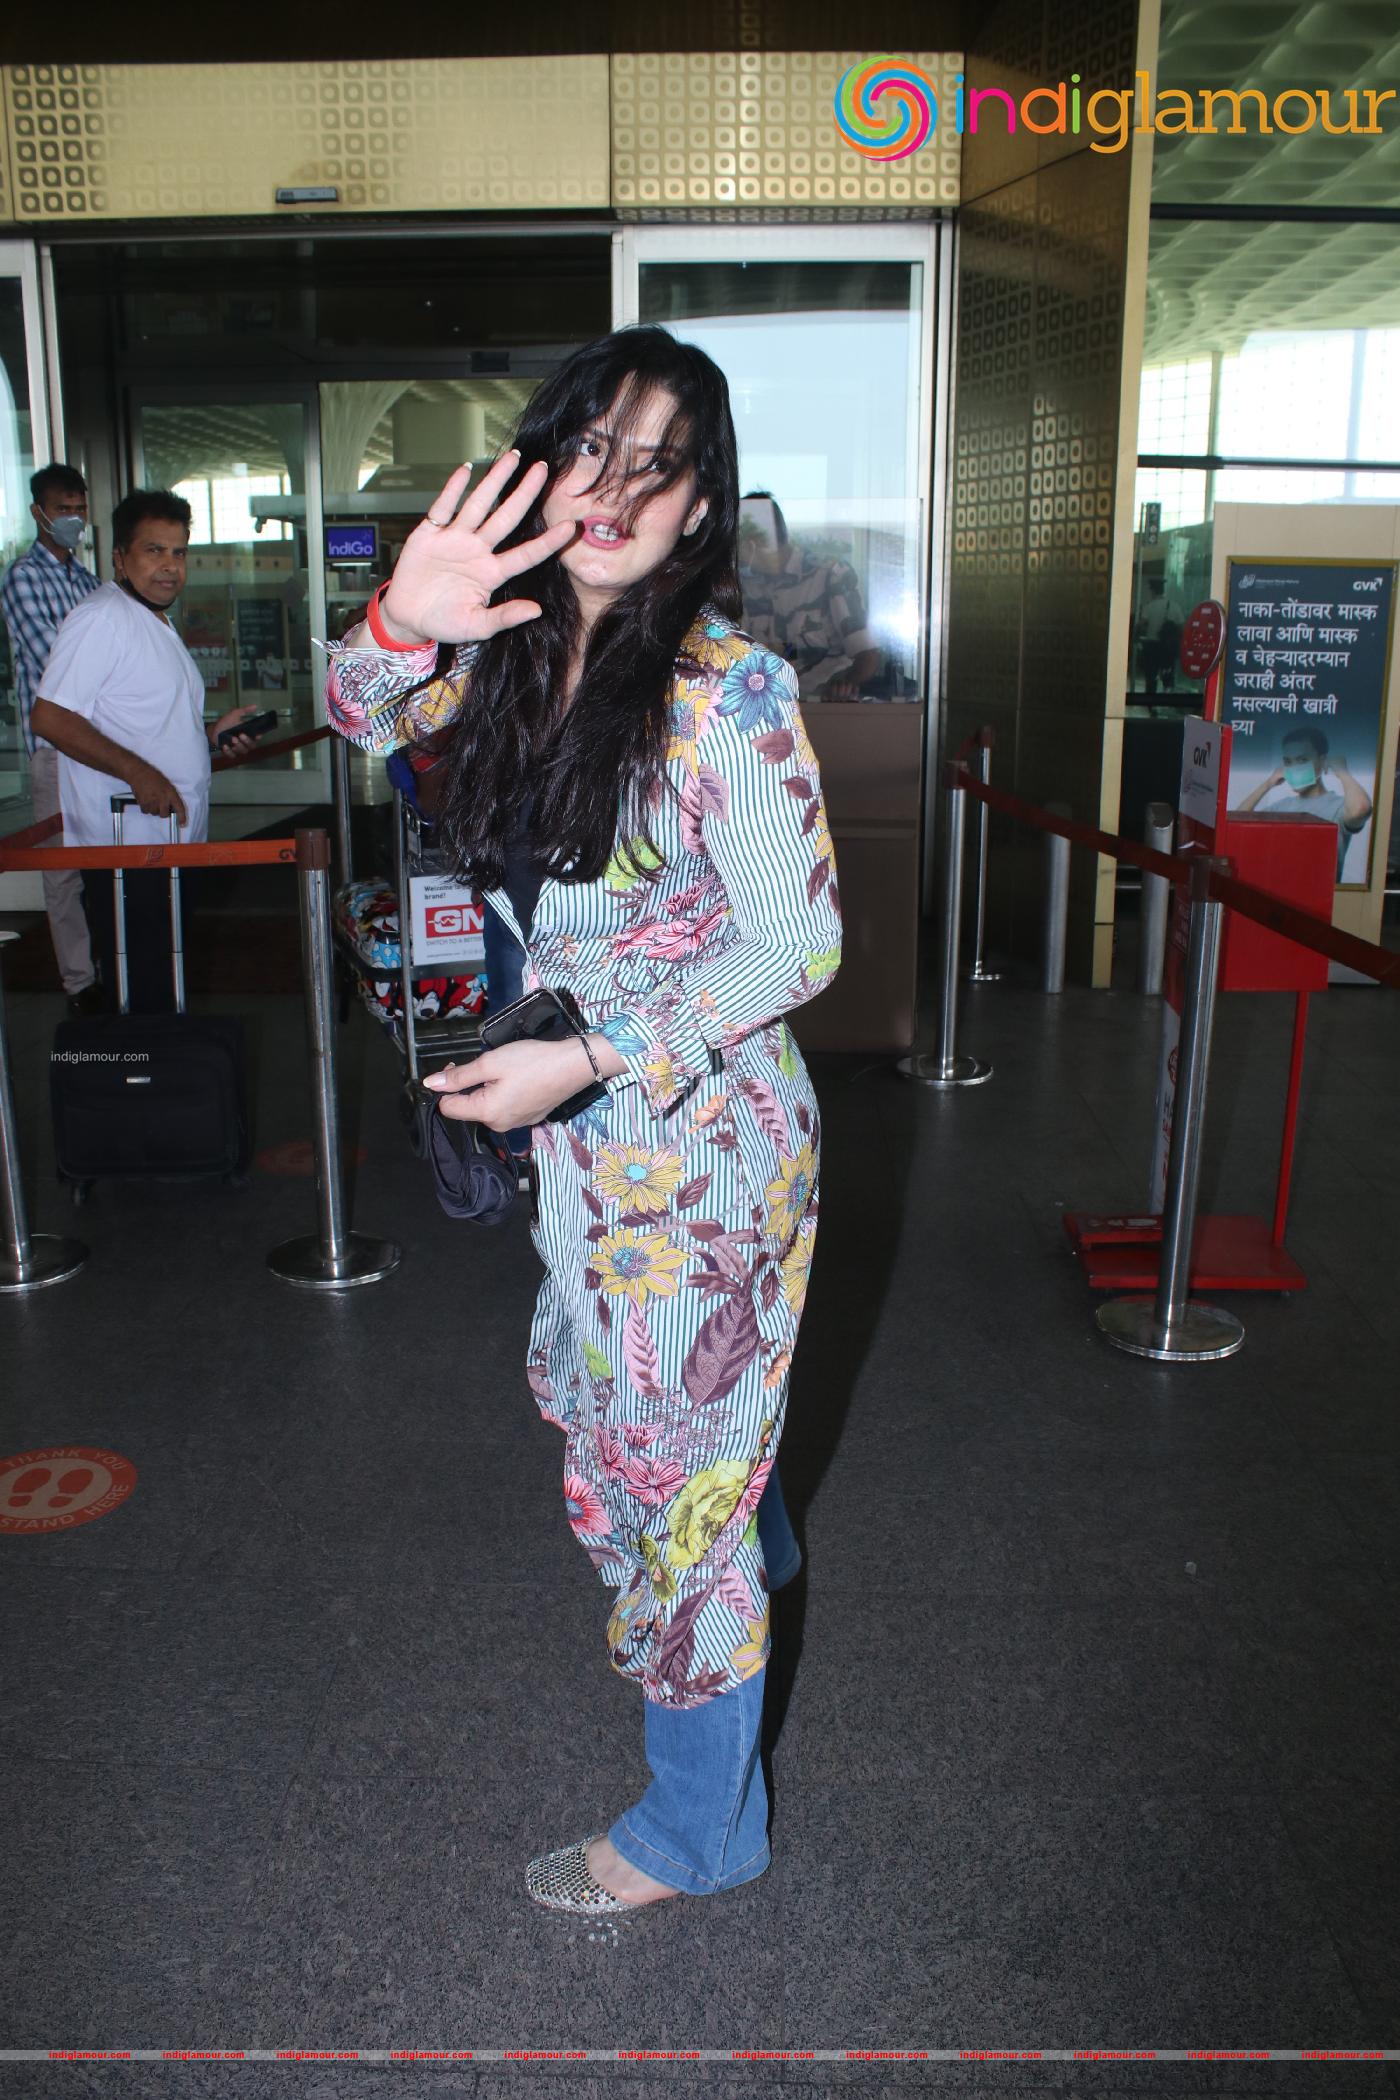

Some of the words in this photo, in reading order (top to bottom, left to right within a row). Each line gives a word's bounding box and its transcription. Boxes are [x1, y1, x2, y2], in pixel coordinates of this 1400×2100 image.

[328, 541, 373, 555] IndiGo
[1353, 579, 1380, 591] GVK
[1238, 598, 1333, 620] नाका-तोंडावर
[1337, 604, 1378, 621] मास्क
[1237, 625, 1272, 643] लावा
[1276, 623, 1315, 644] आणि
[1318, 628, 1359, 645] मास्क
[1235, 650, 1249, 666] व
[1234, 669, 1275, 691] जराही
[1280, 671, 1316, 690] अंतर
[1232, 693, 1298, 714] नसल्याची
[1303, 694, 1338, 715] खात्री
[1194, 745, 1208, 768] GVK
[6, 1450, 80, 1467] THANK
[95, 1452, 128, 1470] YOU
[0, 1514, 75, 1528] STAND
[84, 1485, 129, 1515] HERE
